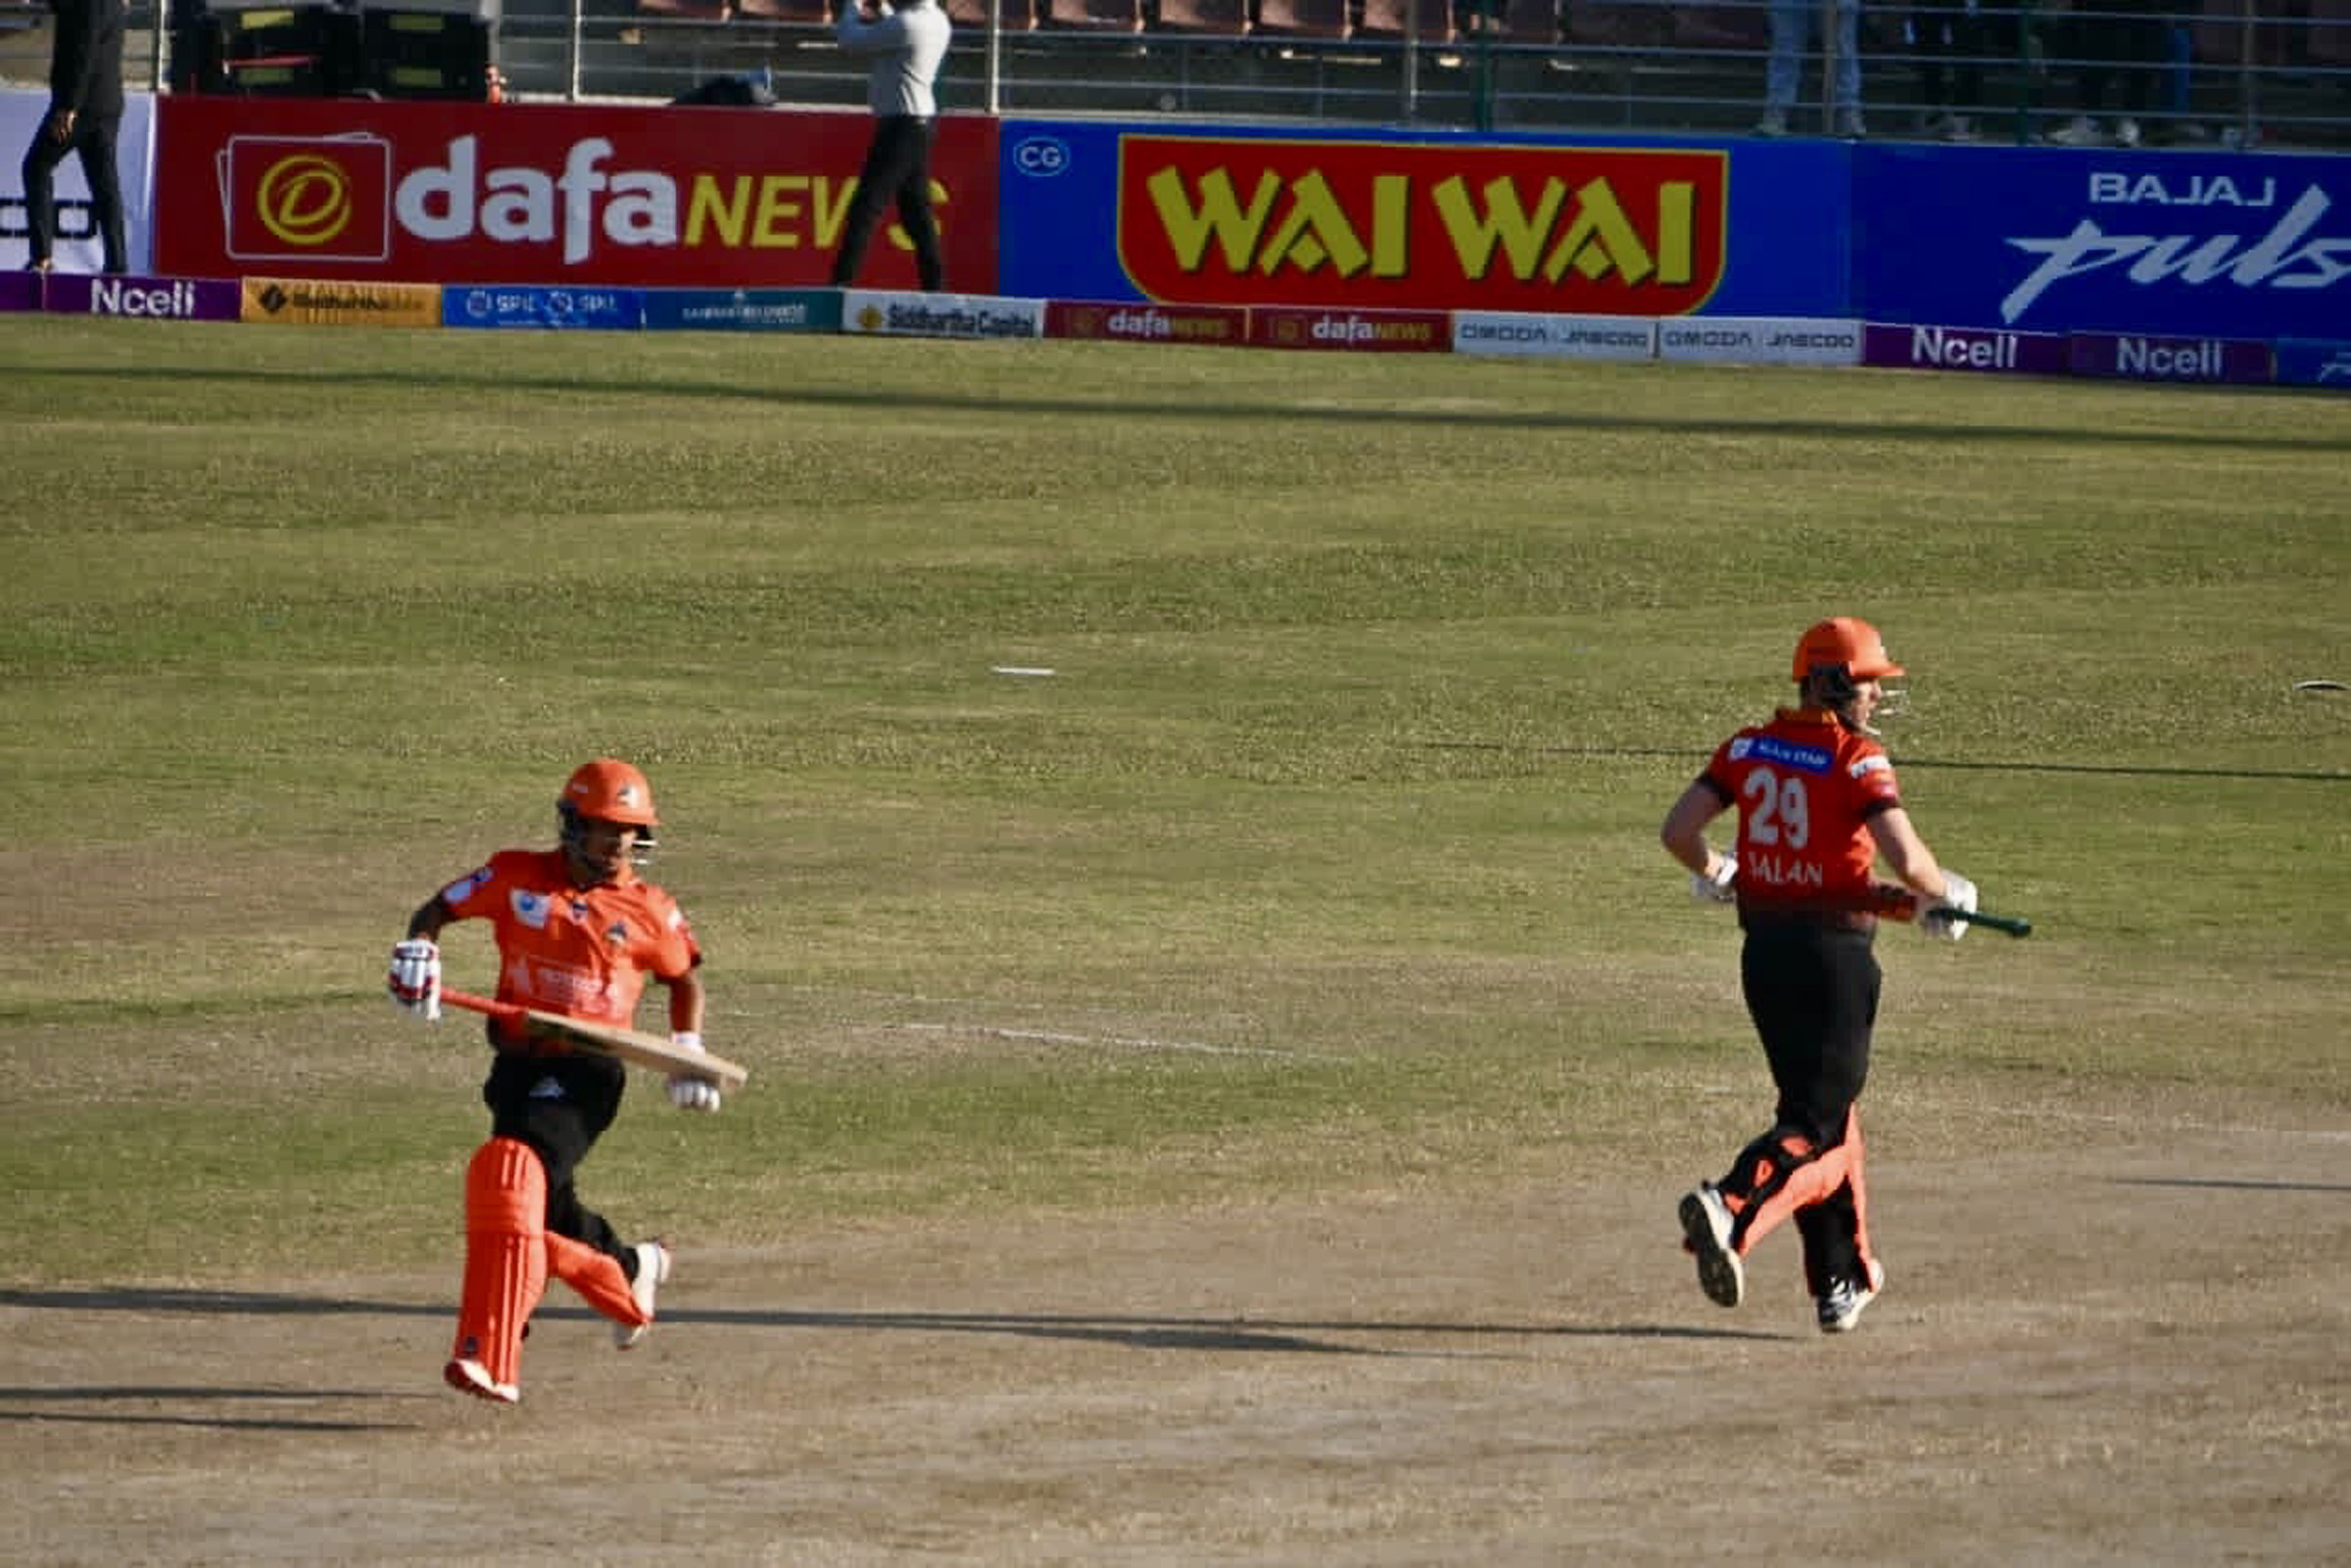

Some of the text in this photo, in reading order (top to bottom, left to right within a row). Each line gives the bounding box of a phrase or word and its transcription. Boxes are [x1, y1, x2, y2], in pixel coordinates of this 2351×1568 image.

[1020, 146, 1062, 167] CG
[2089, 172, 2276, 206] BAJAJ
[1146, 166, 1696, 288] WAI WAI
[90, 278, 196, 316] Ncell
[1911, 325, 2018, 368] Ncell
[2116, 336, 2223, 377] Ncell
[1744, 767, 1809, 850] 29
